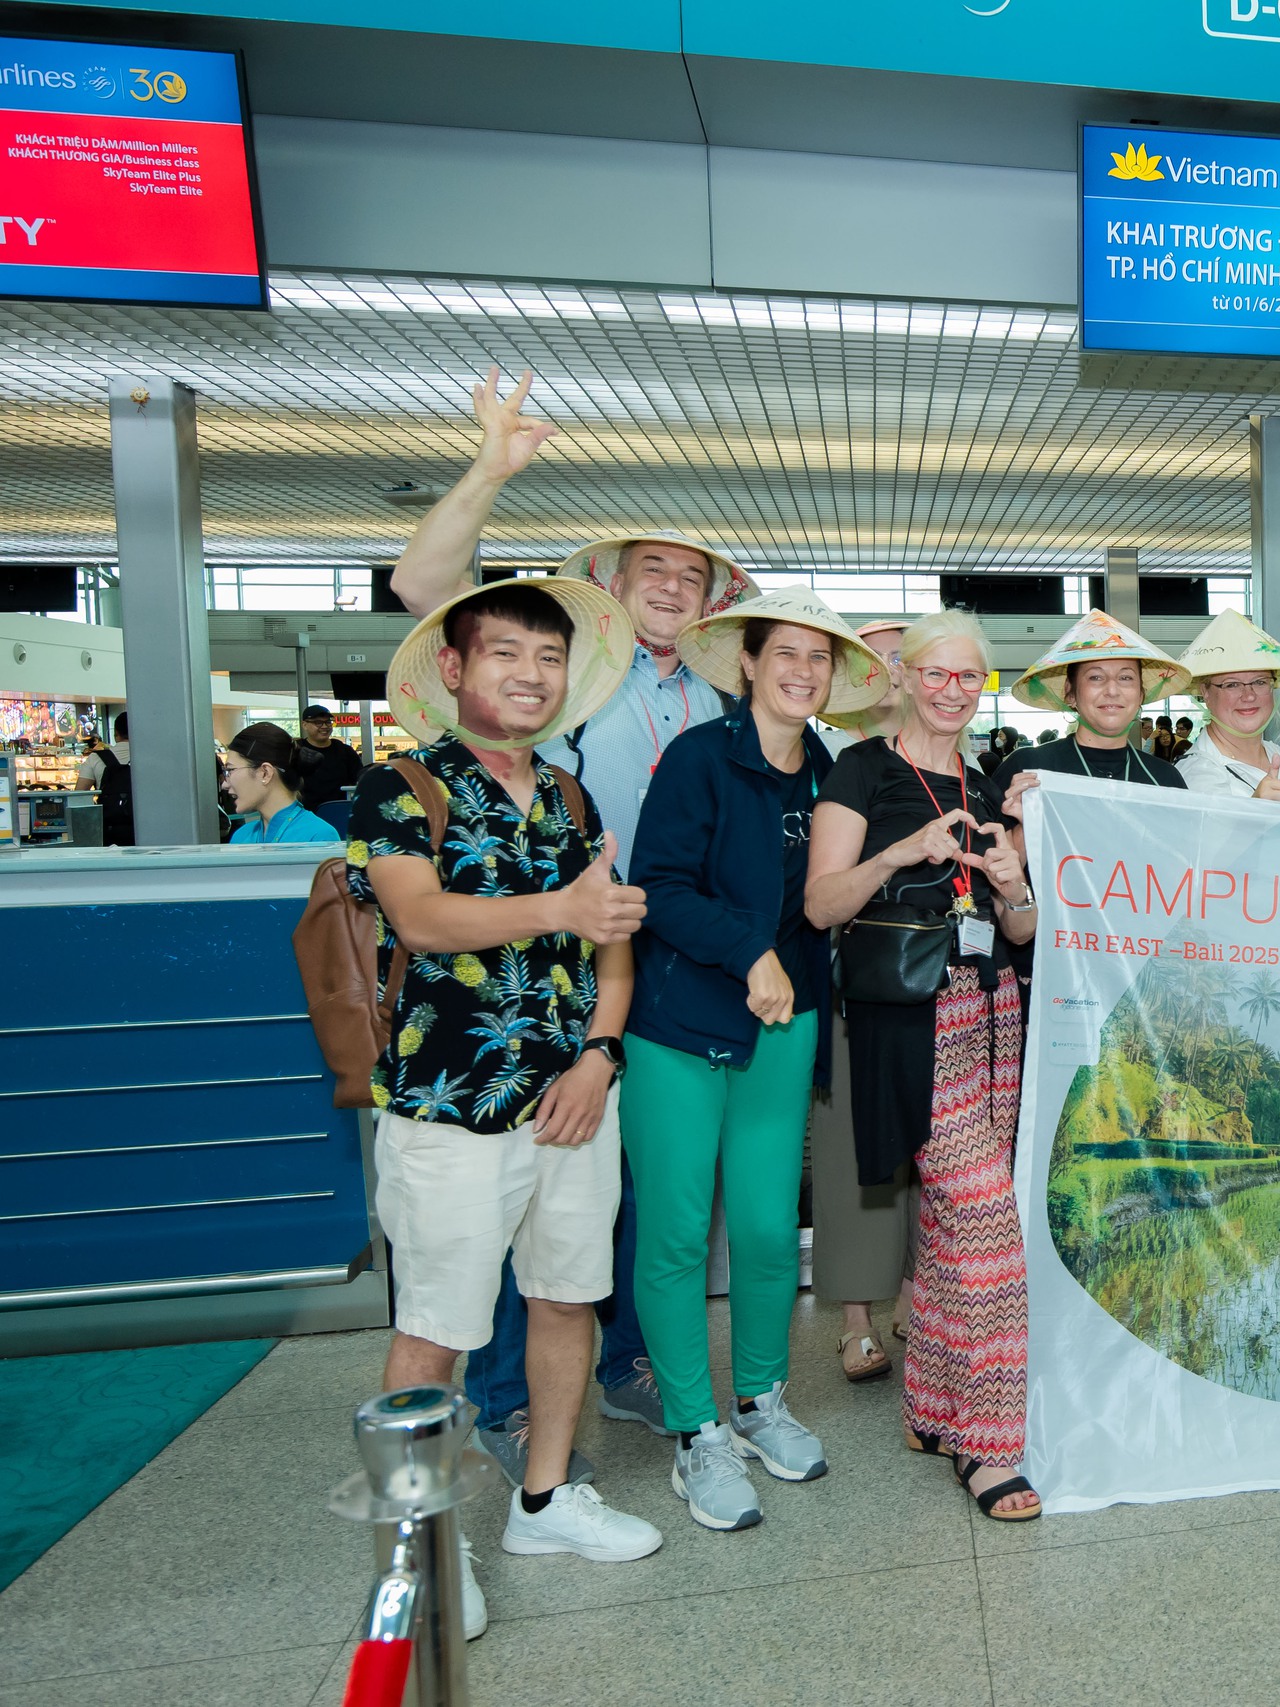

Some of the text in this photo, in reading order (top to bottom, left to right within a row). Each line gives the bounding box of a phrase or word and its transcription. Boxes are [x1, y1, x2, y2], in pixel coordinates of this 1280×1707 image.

[0, 62, 77, 89] rlines
[15, 133, 56, 146] KHÁCH
[56, 136, 89, 150] TRIỆU
[162, 143, 199, 155] Millers
[7, 147, 200, 168] KHÁCH THƯƠNG GIA/Business class
[103, 167, 202, 183] SkyTeam Elite Plus
[1165, 155, 1278, 188] Vietnam
[129, 183, 203, 196] SkyTeam Elite
[1106, 221, 1164, 247] KHAI
[1170, 223, 1273, 253] TRƯƠNG
[1106, 255, 1137, 280] TP.
[1143, 251, 1176, 282] HỒ
[1182, 256, 1221, 284] CHÍ
[1213, 295, 1230, 310] từ
[335, 715, 360, 724] LUCK
[1054, 929, 1099, 952] FAR
[1105, 934, 1163, 957] EAST
[1229, 945, 1280, 965] 2025
